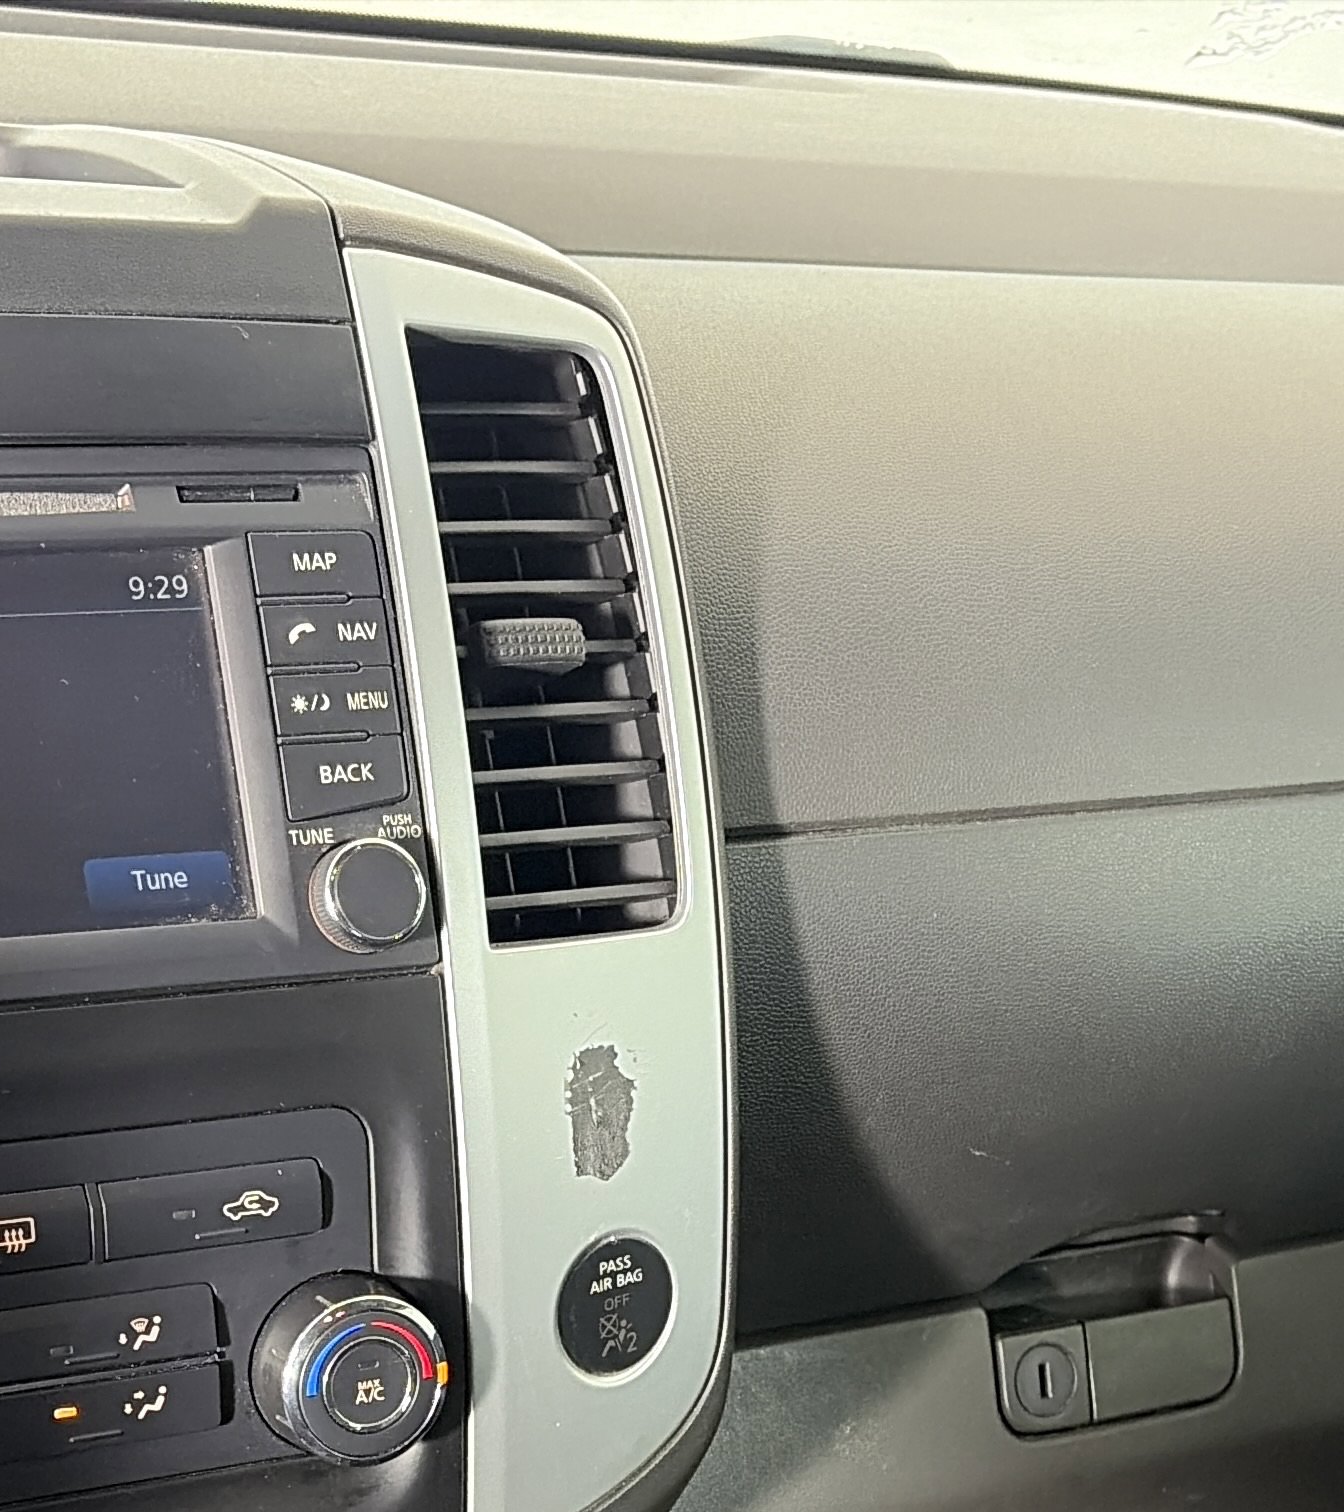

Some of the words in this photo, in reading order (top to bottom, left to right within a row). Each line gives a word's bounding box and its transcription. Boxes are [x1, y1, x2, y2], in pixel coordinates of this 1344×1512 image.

[292, 552, 337, 572] MAP
[128, 574, 189, 600] 9:29
[337, 621, 378, 642] NAV
[346, 690, 389, 711] MENU
[319, 763, 375, 785] BACK
[382, 814, 413, 827] PUSH
[288, 827, 335, 846] TUNE
[377, 825, 422, 840] AUDIO
[130, 869, 189, 893] Tune
[599, 1254, 632, 1276] PASS
[589, 1277, 613, 1296] AIR
[616, 1268, 644, 1289] BAG
[603, 1292, 632, 1312] OFF
[357, 1378, 381, 1390] MAX
[355, 1386, 386, 1405] A/C
